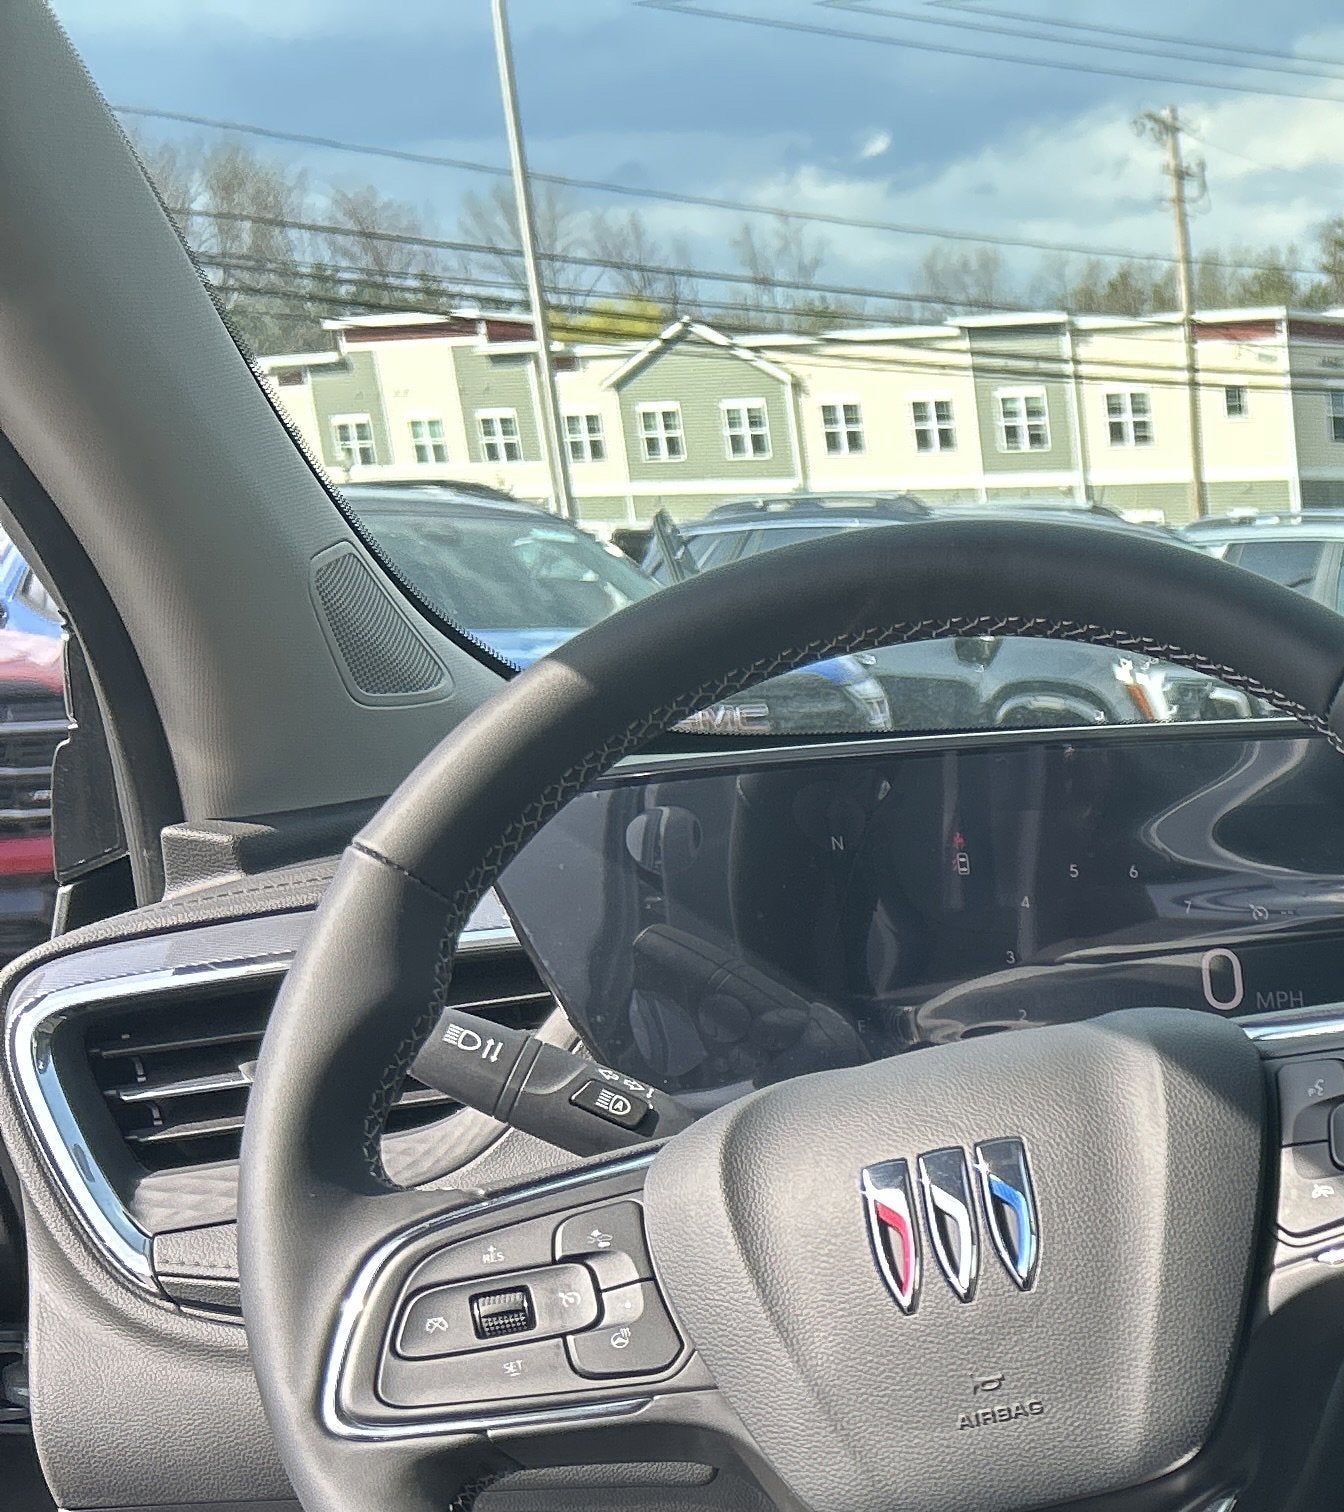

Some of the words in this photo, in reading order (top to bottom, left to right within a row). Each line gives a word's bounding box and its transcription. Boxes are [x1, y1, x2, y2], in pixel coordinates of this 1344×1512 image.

[830, 834, 846, 851] N
[1069, 864, 1079, 878] 5
[1129, 865, 1139, 879] 6
[1020, 895, 1031, 909] 4
[1183, 899, 1192, 914] 7
[1006, 951, 1016, 965] 3
[1201, 947, 1244, 1010] 0
[1255, 990, 1304, 1011] MPH
[482, 1251, 505, 1264] RES
[503, 1359, 523, 1373] SET
[958, 1399, 1045, 1431] AIRBAG
